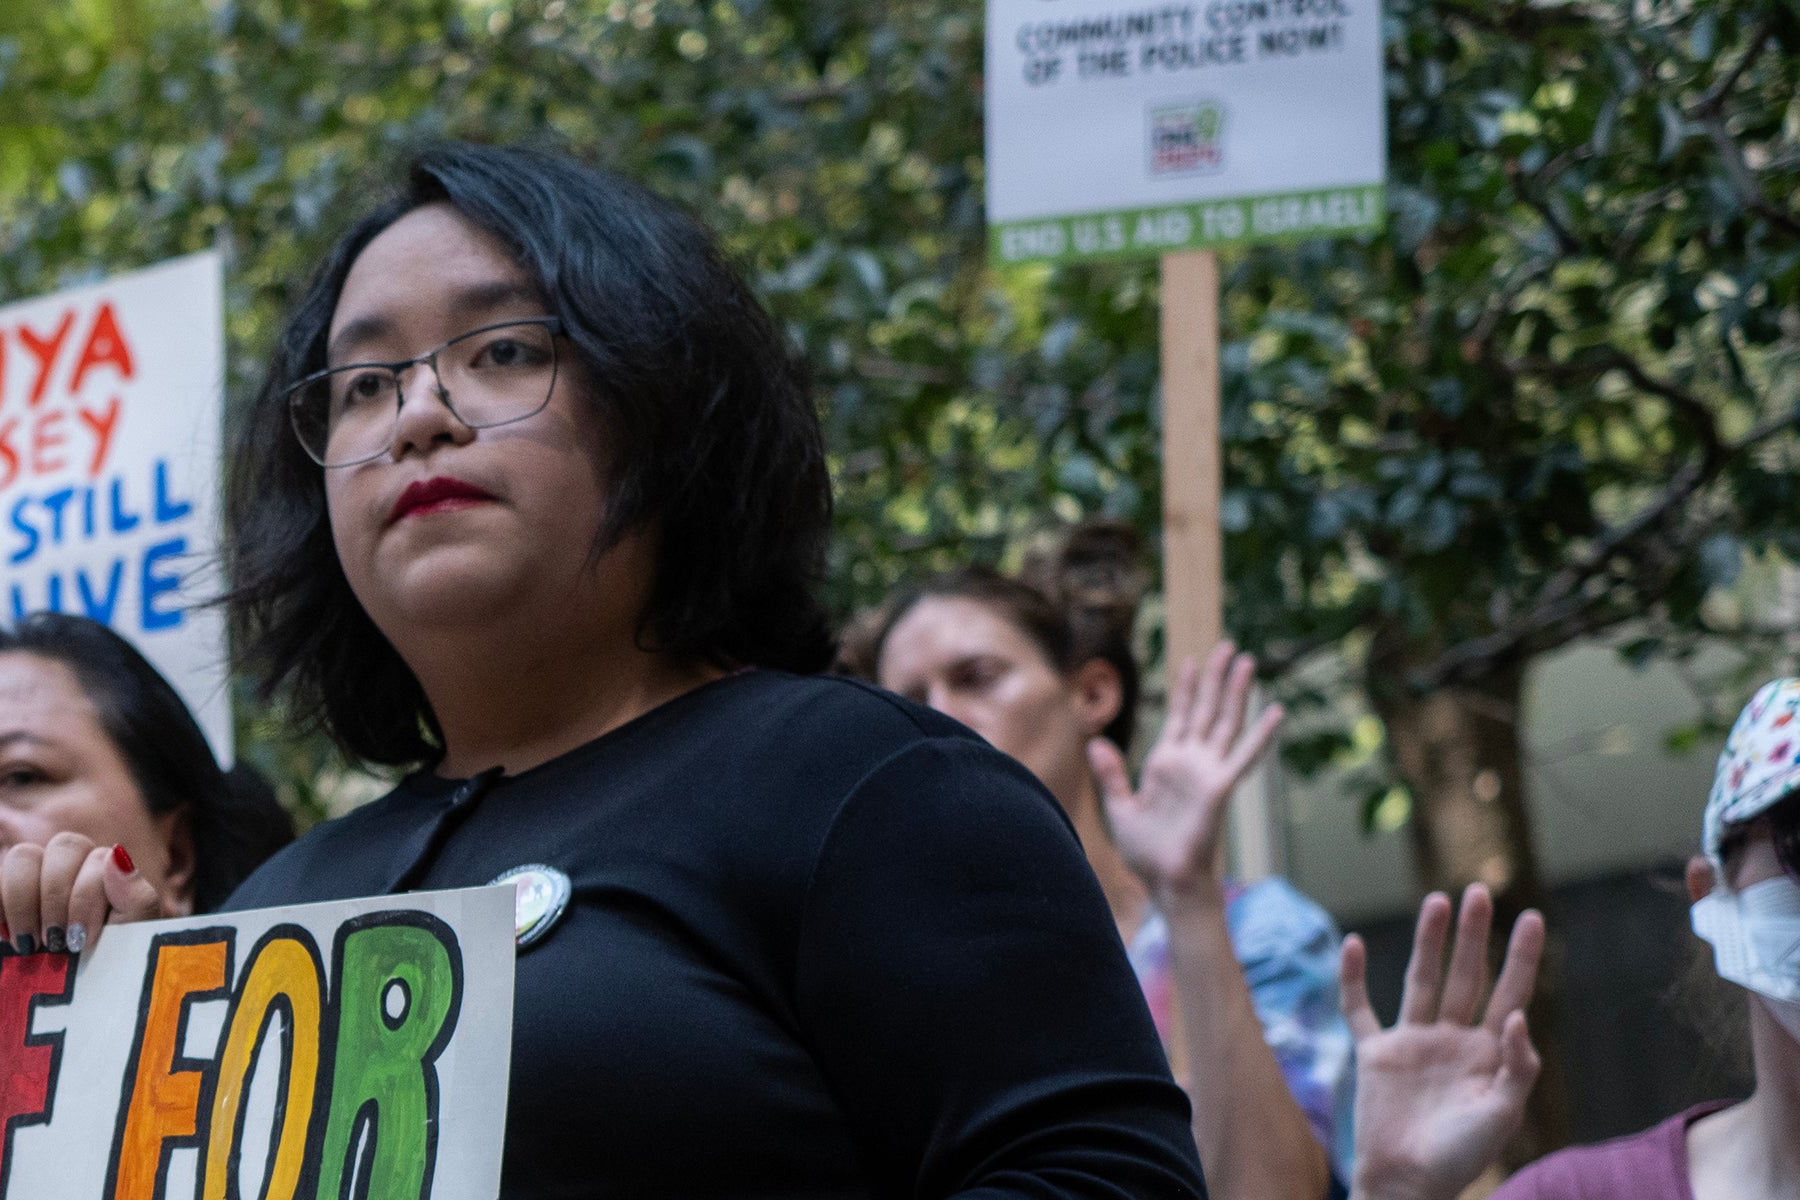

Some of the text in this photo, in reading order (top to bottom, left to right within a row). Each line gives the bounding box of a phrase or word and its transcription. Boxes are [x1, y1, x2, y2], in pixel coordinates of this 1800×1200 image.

[1022, 56, 1063, 88] OF
[1077, 50, 1130, 79] THE
[1138, 35, 1246, 71] POLICE
[6, 458, 193, 564] STILL
